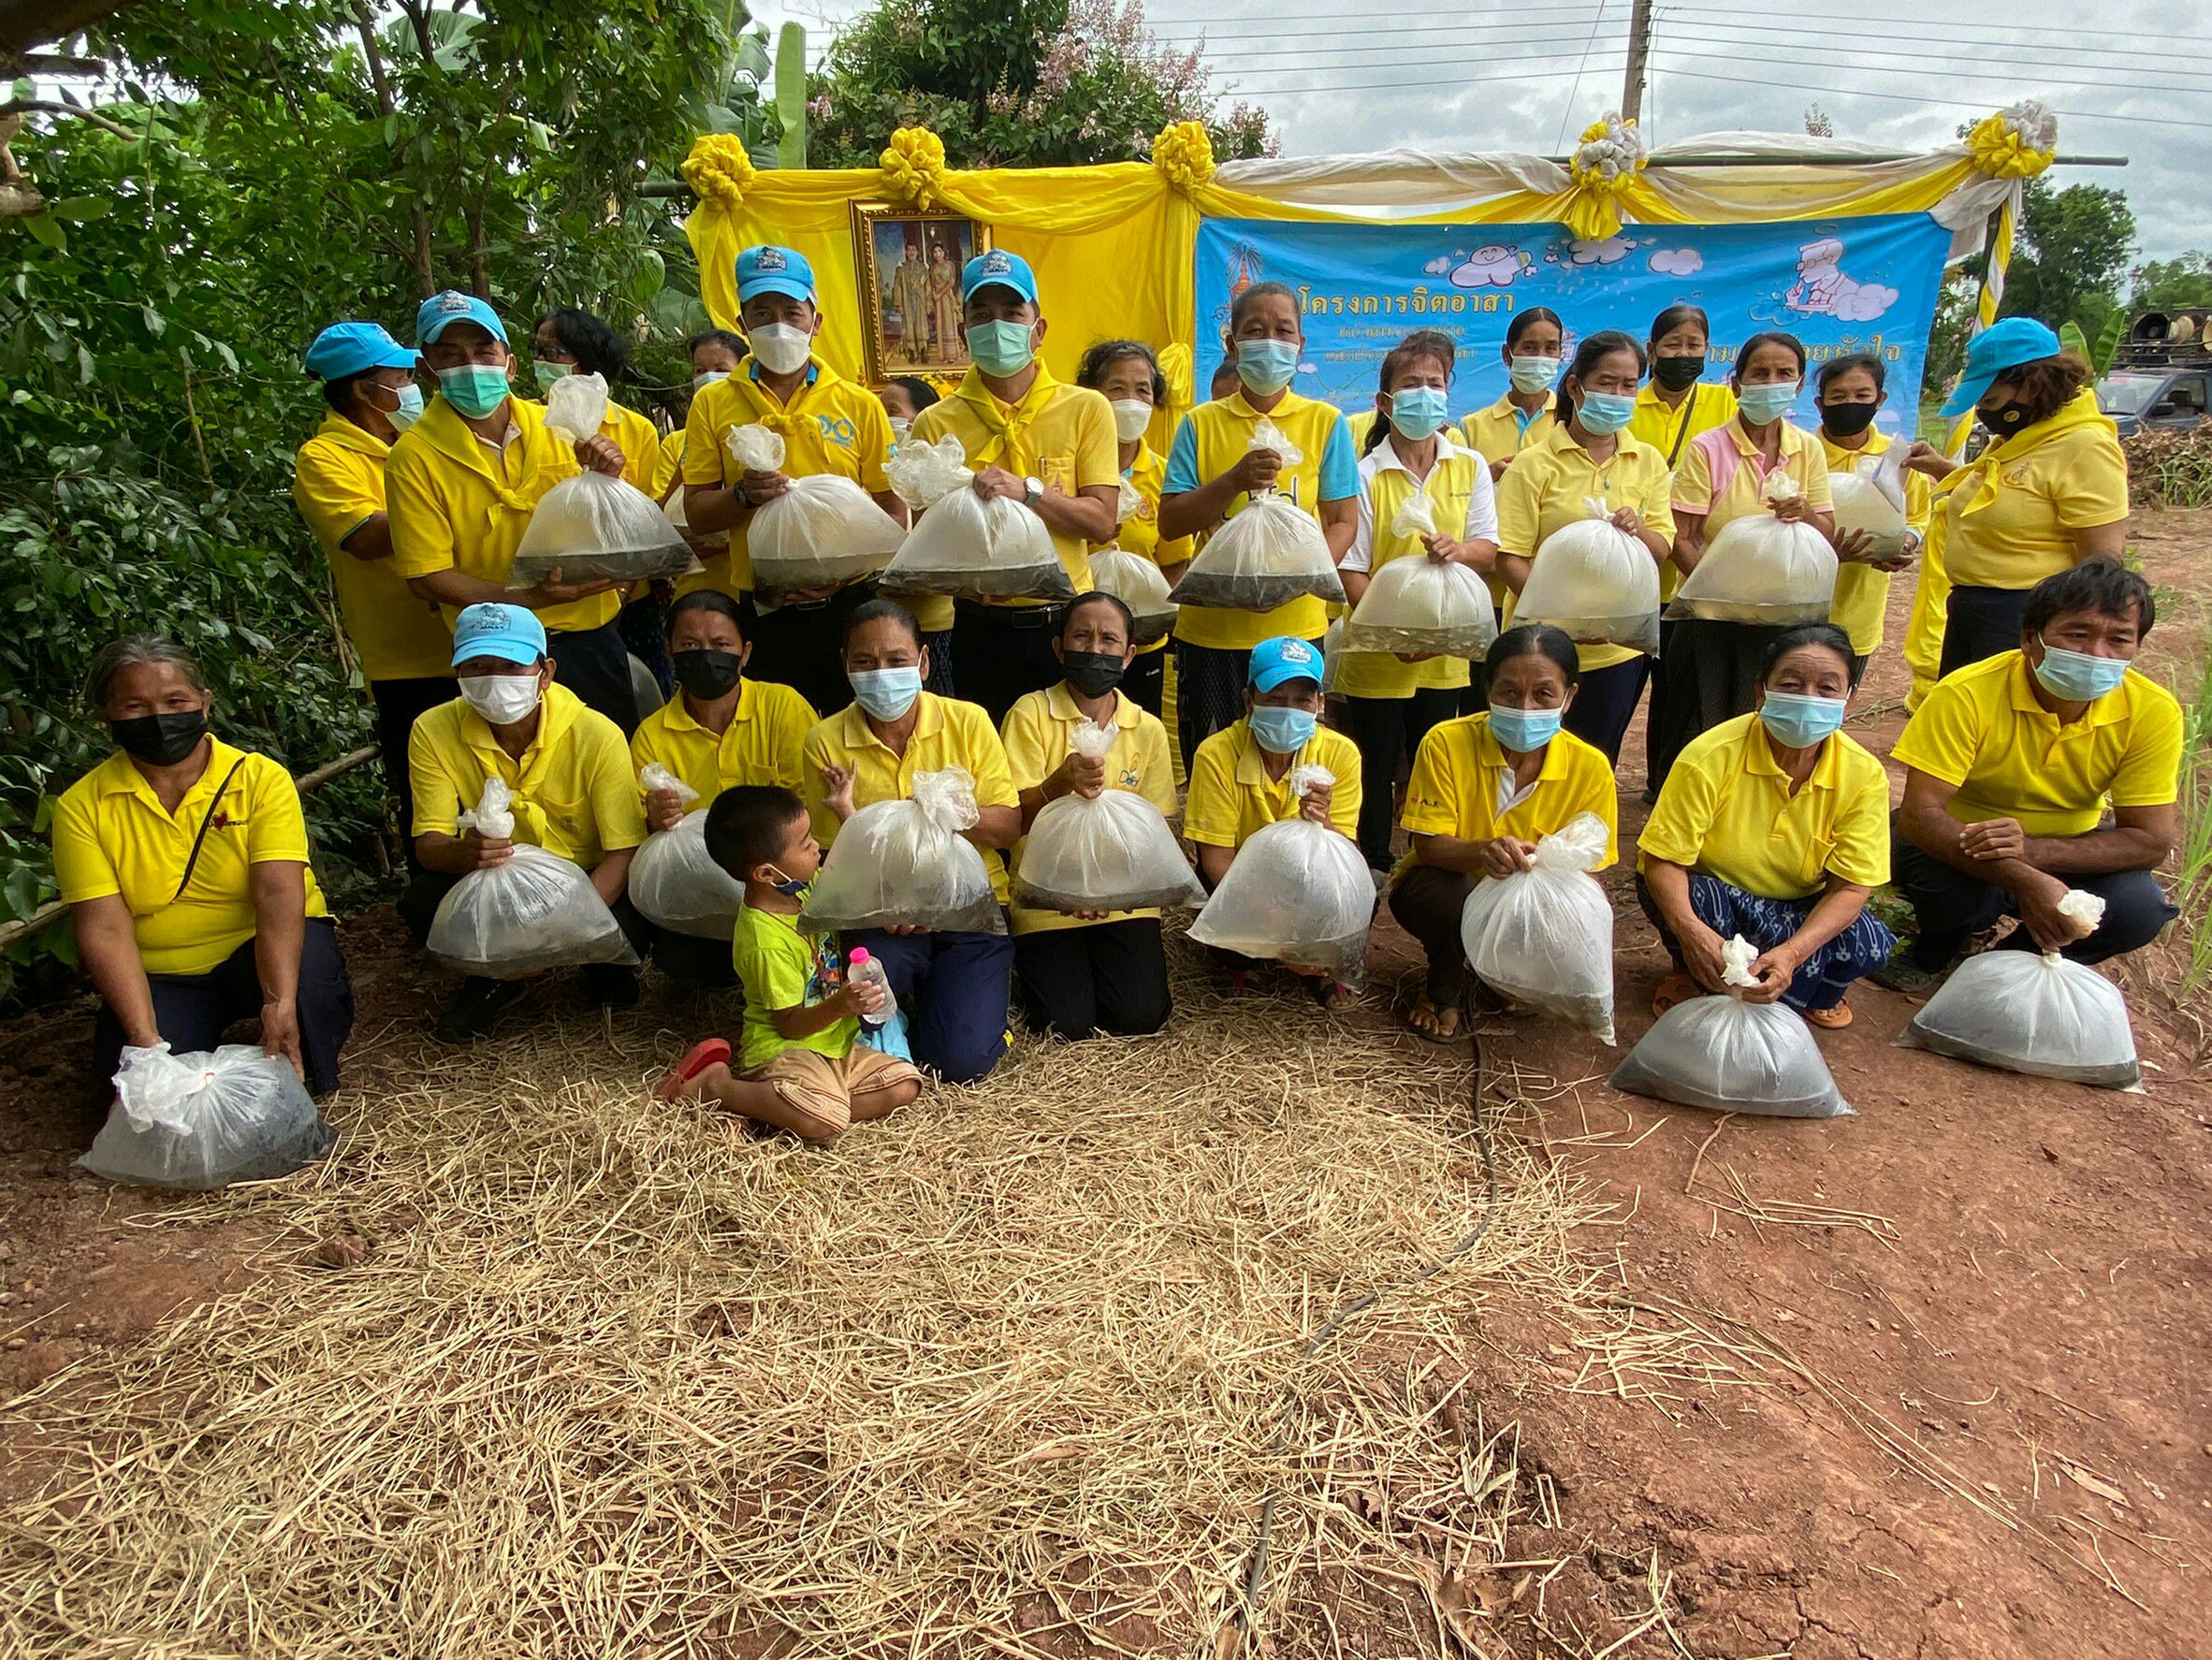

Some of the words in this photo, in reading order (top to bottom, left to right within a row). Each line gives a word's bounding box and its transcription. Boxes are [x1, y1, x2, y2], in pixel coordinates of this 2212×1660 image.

[1297, 284, 1515, 314] โครงการจิตอาสา
